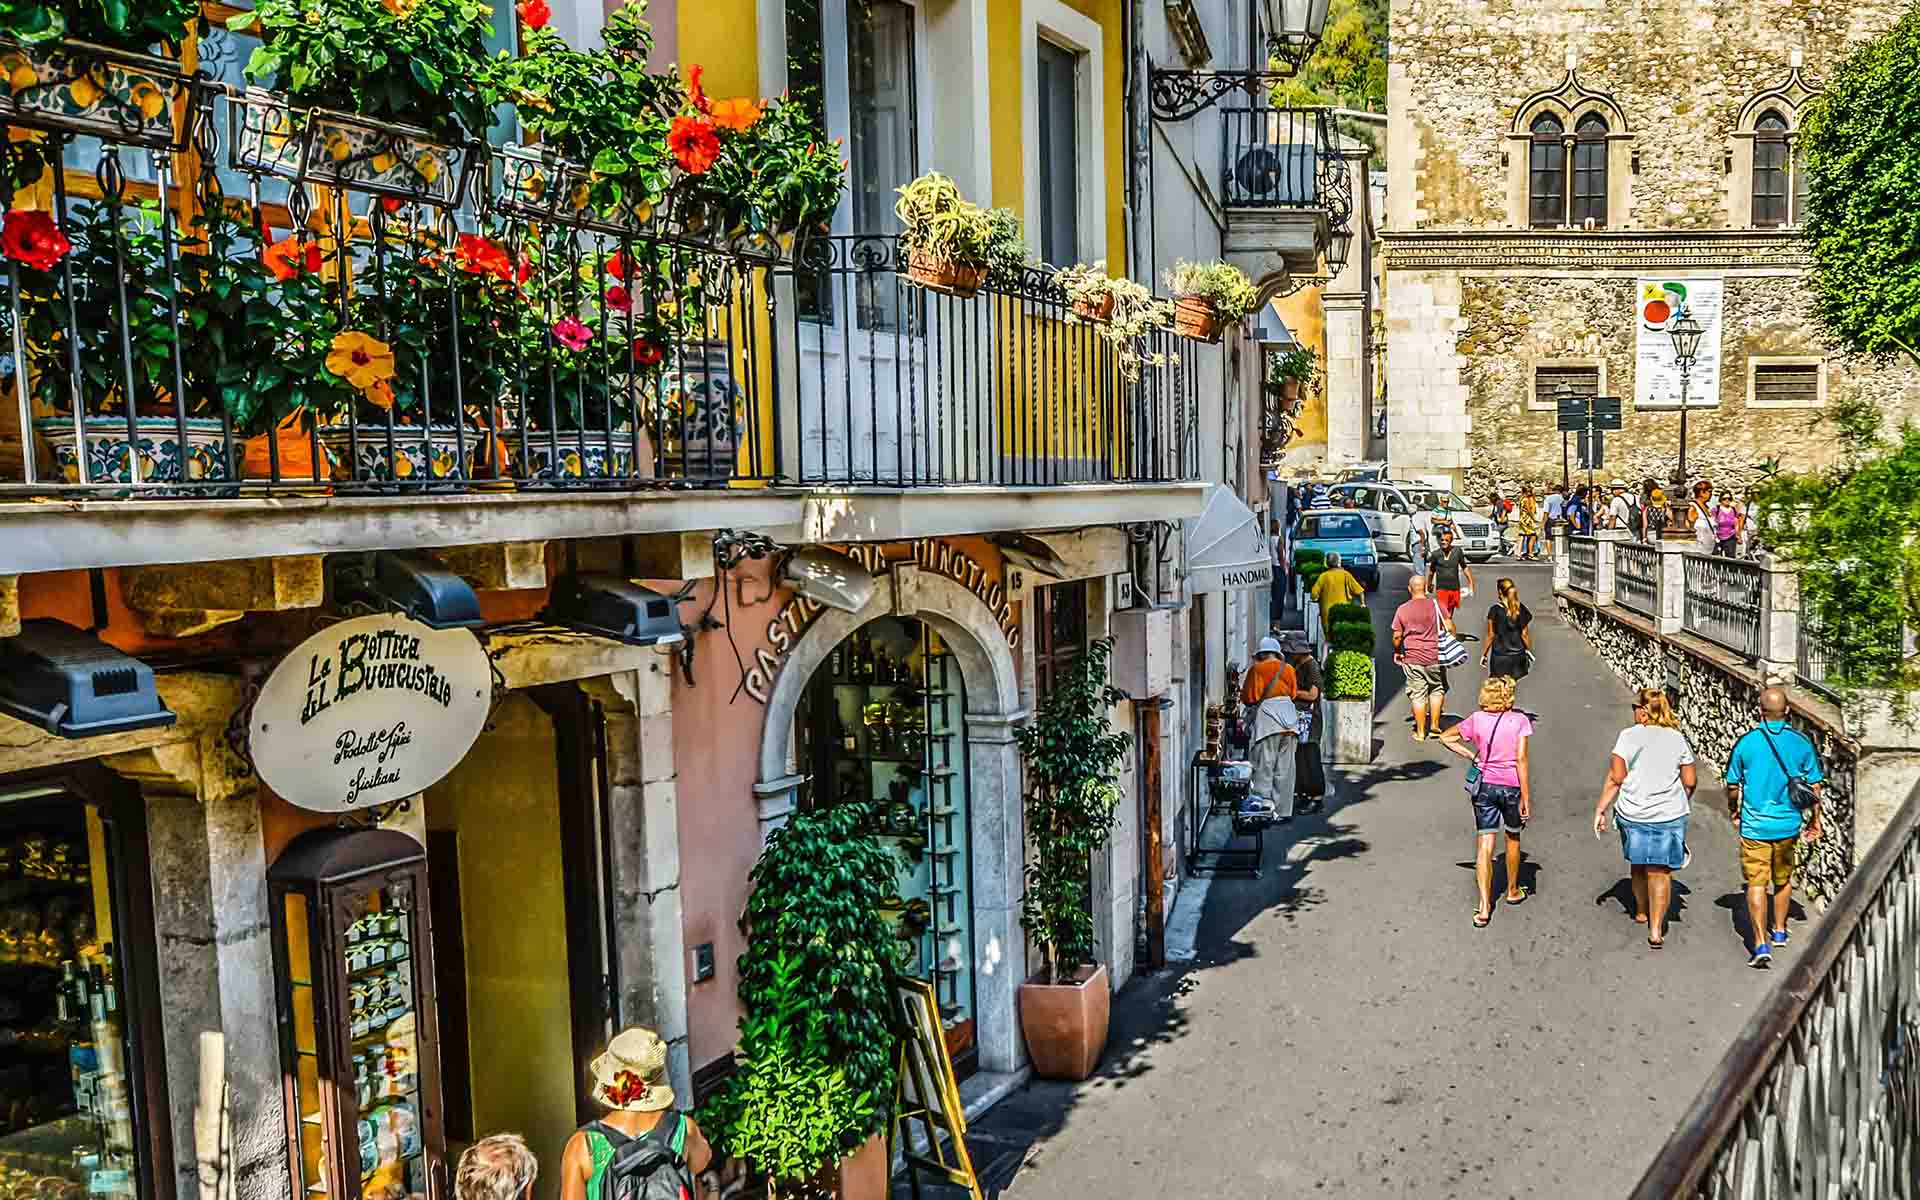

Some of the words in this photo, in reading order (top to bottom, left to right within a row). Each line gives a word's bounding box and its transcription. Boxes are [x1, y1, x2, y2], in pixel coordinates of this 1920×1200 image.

[1011, 571, 1022, 590] 15
[746, 545, 887, 704] PASTICIA
[334, 730, 380, 764] Prodotti
[347, 766, 401, 804] Siciliani
